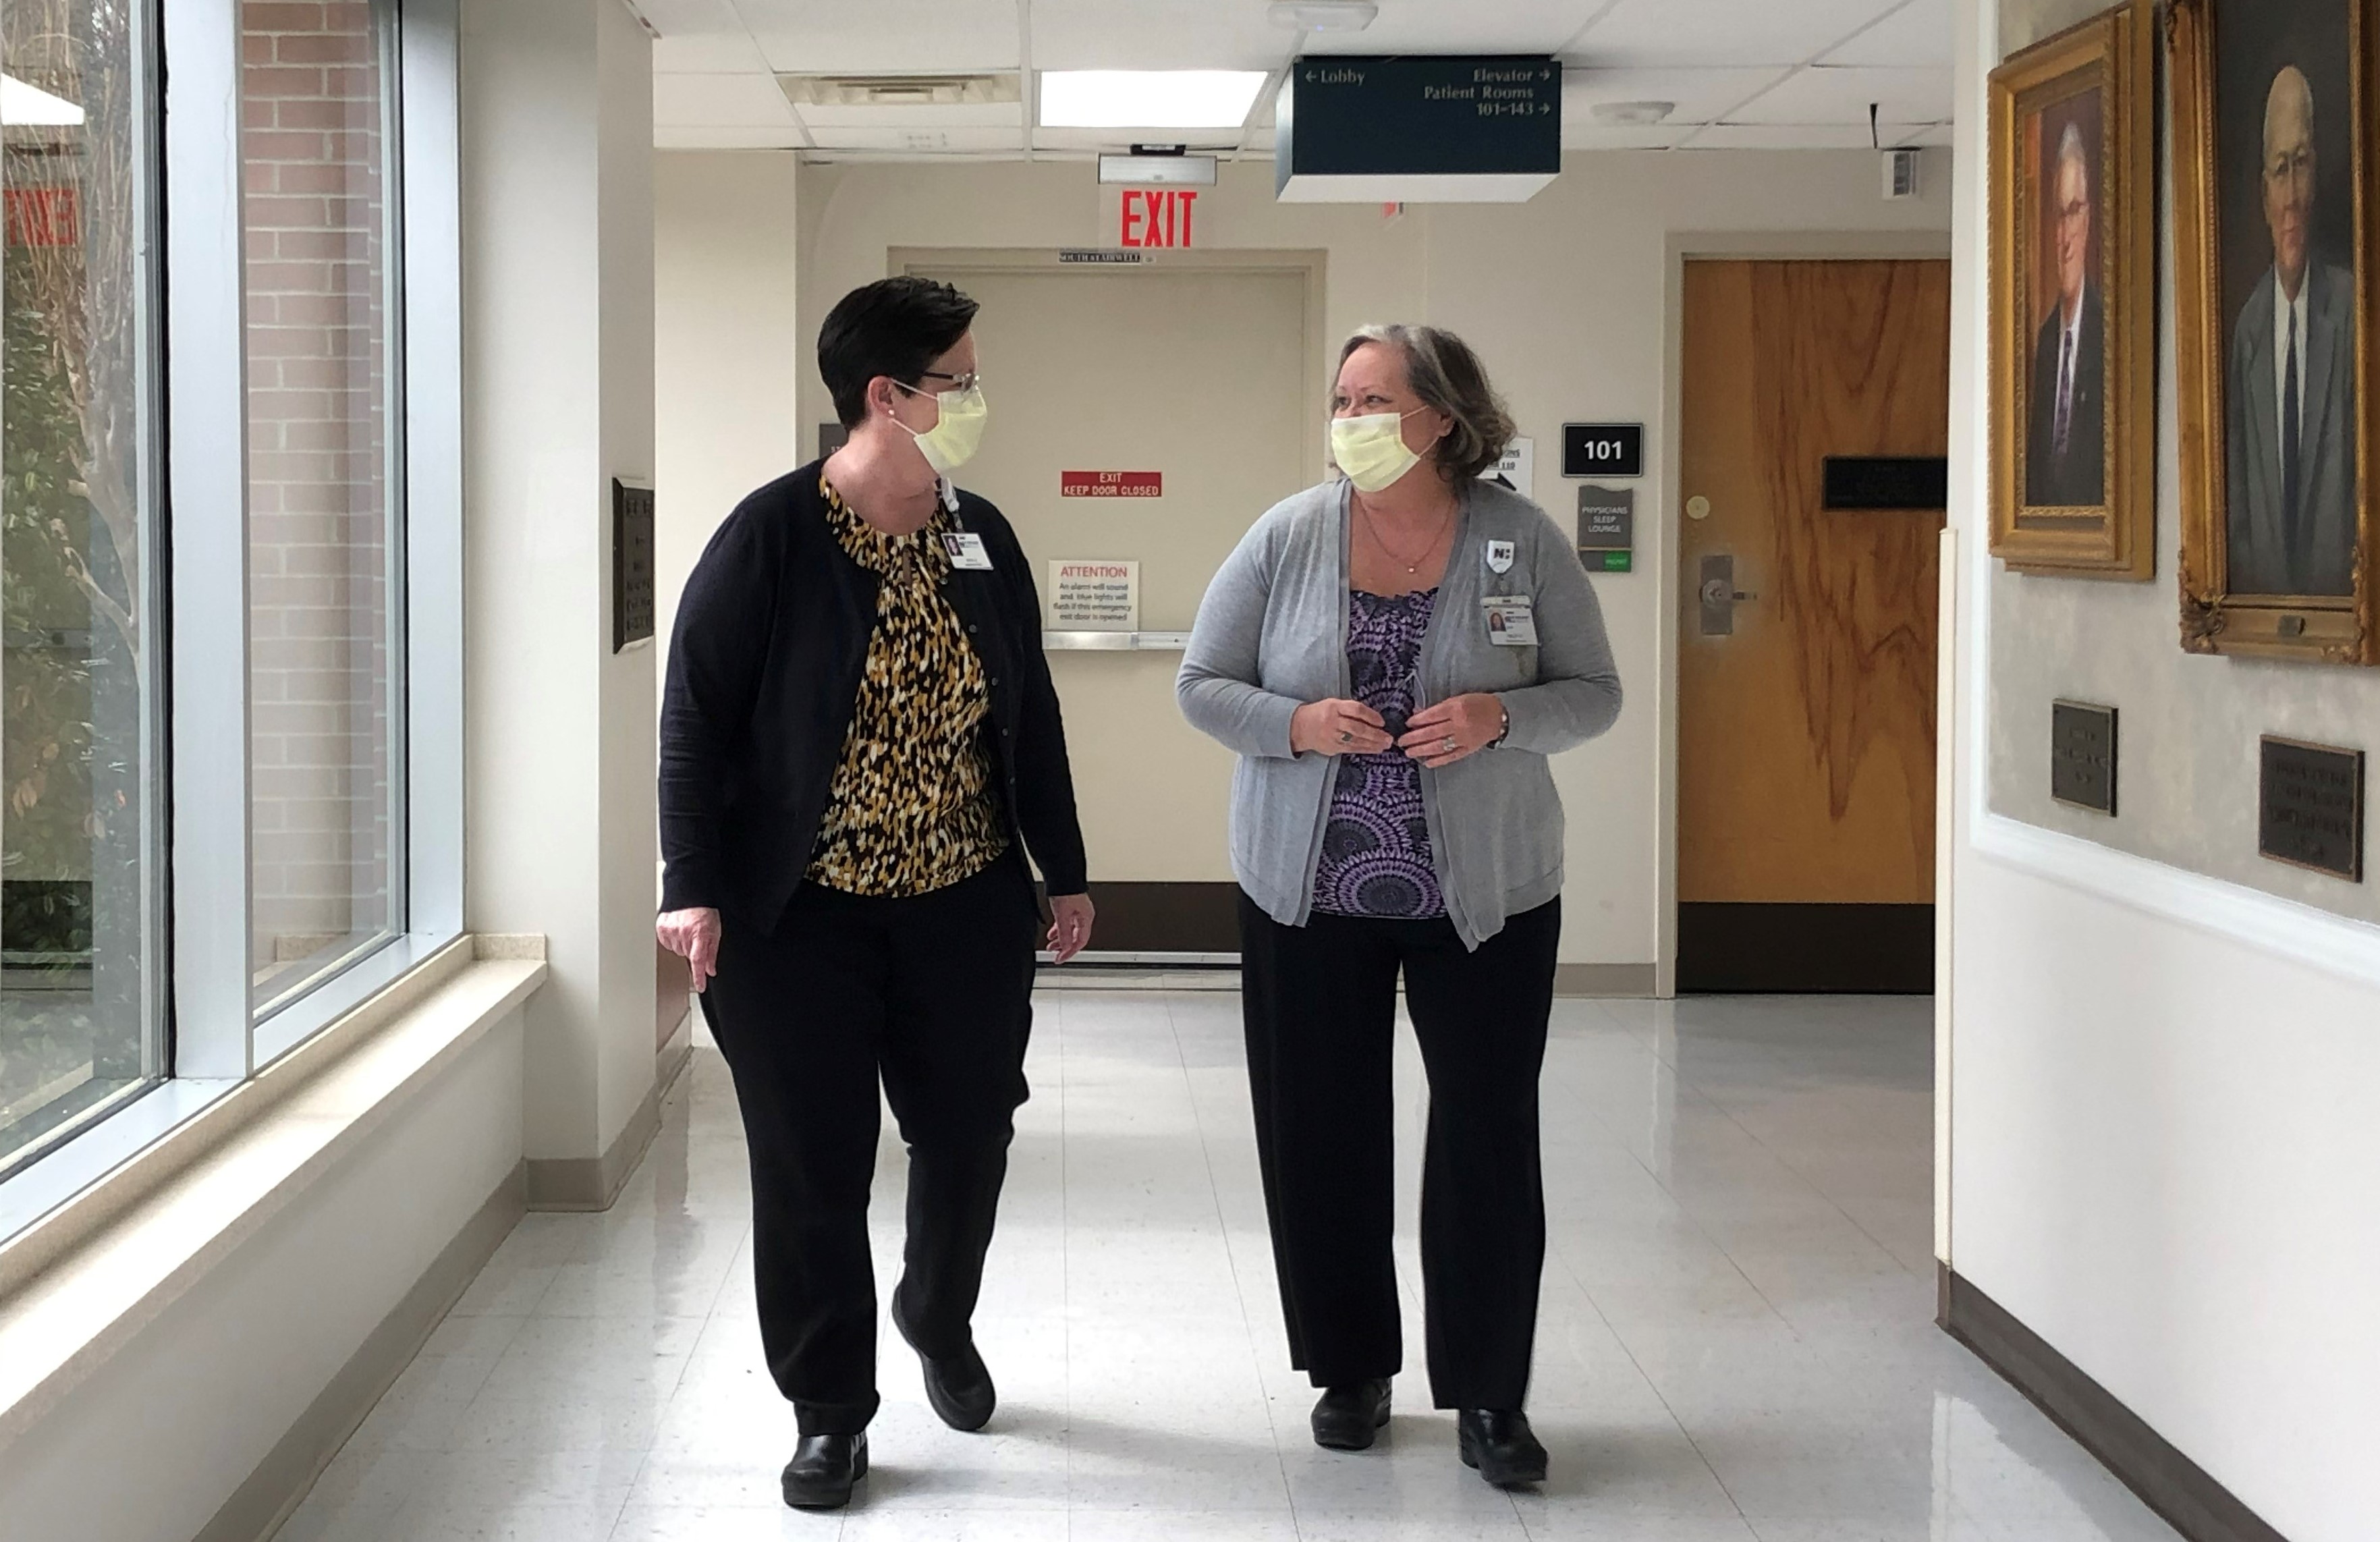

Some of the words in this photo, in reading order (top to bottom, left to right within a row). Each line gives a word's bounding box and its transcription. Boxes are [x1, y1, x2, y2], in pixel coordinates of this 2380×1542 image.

[1321, 70, 1365, 85] Lobby
[1474, 69, 1533, 82] Elevator
[1424, 86, 1474, 99] Patient
[1483, 86, 1534, 99] Rooms
[1476, 103, 1534, 115] 101-143
[1122, 190, 1197, 248] EXIT
[1584, 440, 1622, 460] 101
[1099, 472, 1122, 483] EXIT
[1063, 485, 1089, 495] KEEP
[1092, 485, 1117, 495] DOOR
[1121, 485, 1159, 496] CLOSED
[1582, 506, 1628, 515] PHYSICIANS
[1593, 516, 1617, 524] SLEEP
[1061, 567, 1128, 578] ATTENTION
[1094, 593, 1113, 601] lights
